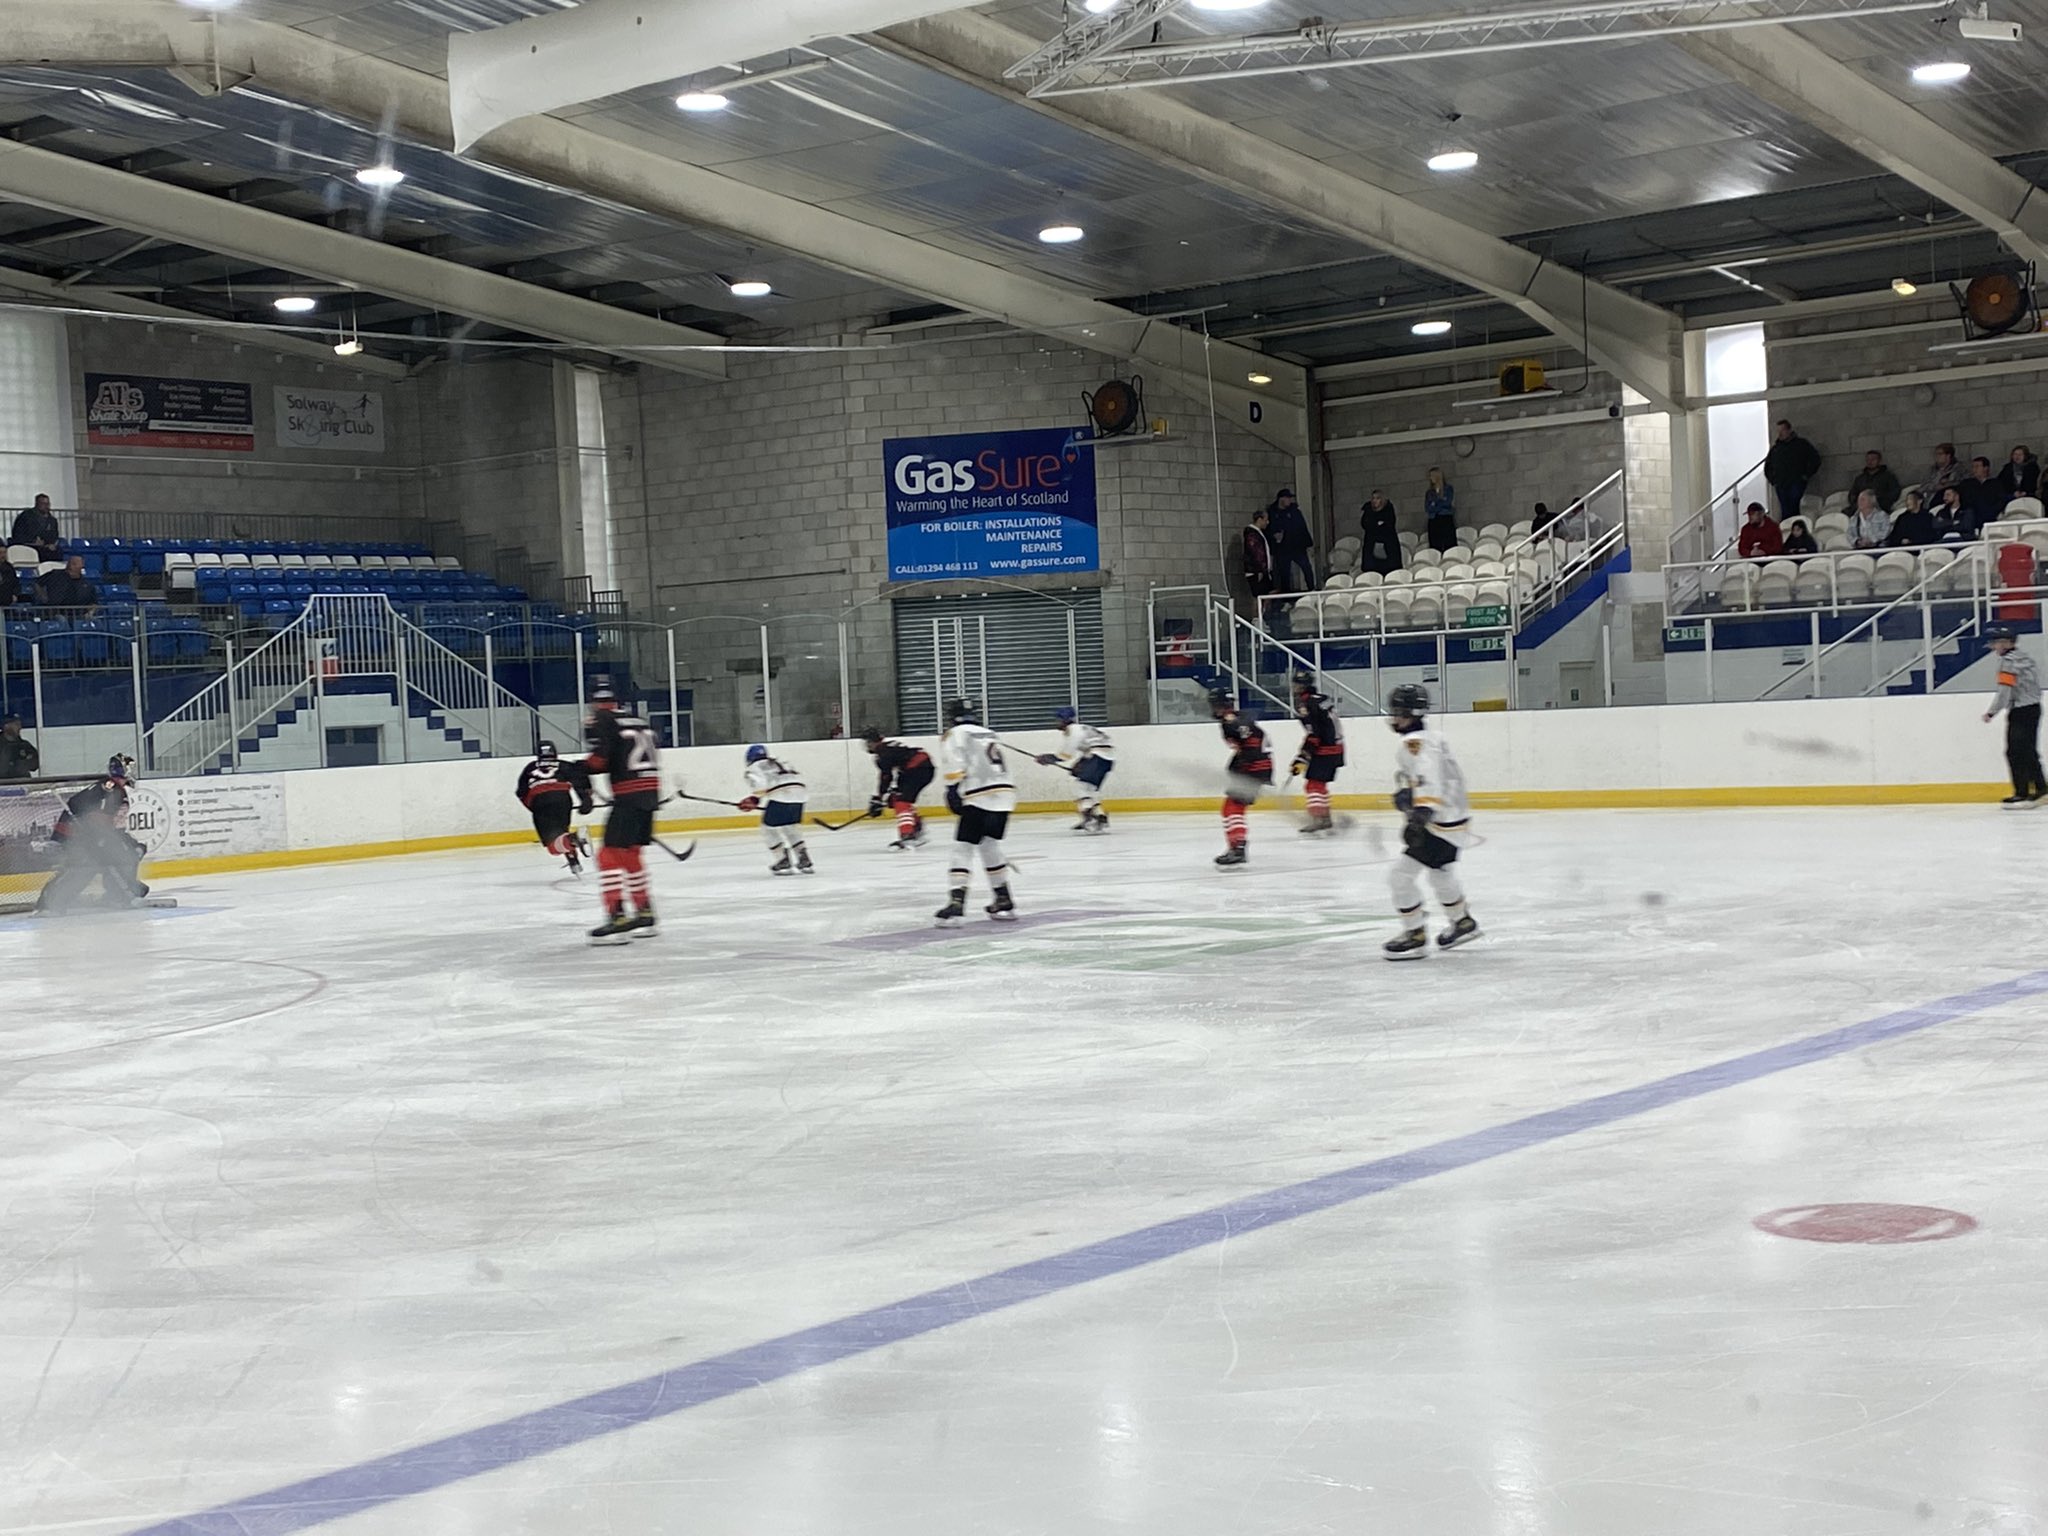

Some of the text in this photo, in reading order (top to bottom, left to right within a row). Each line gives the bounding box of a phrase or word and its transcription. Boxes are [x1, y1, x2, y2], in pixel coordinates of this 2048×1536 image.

[287, 394, 335, 415] Solway
[89, 408, 148, 423] Skate Shop
[1249, 401, 1263, 424] D
[344, 419, 375, 436] Club
[896, 491, 1069, 513] Warming the Heart of Scotland
[921, 516, 1062, 533] FOR BOILER: INSTALLATIONS
[986, 529, 1062, 542] MAINTENANCE
[1021, 542, 1063, 553] REPAIRS
[963, 562, 978, 571] 113
[990, 554, 1086, 569] www.gassure.com
[1467, 608, 1484, 616] FIRST
[1469, 616, 1496, 625] STATION
[128, 811, 155, 831] DELI
